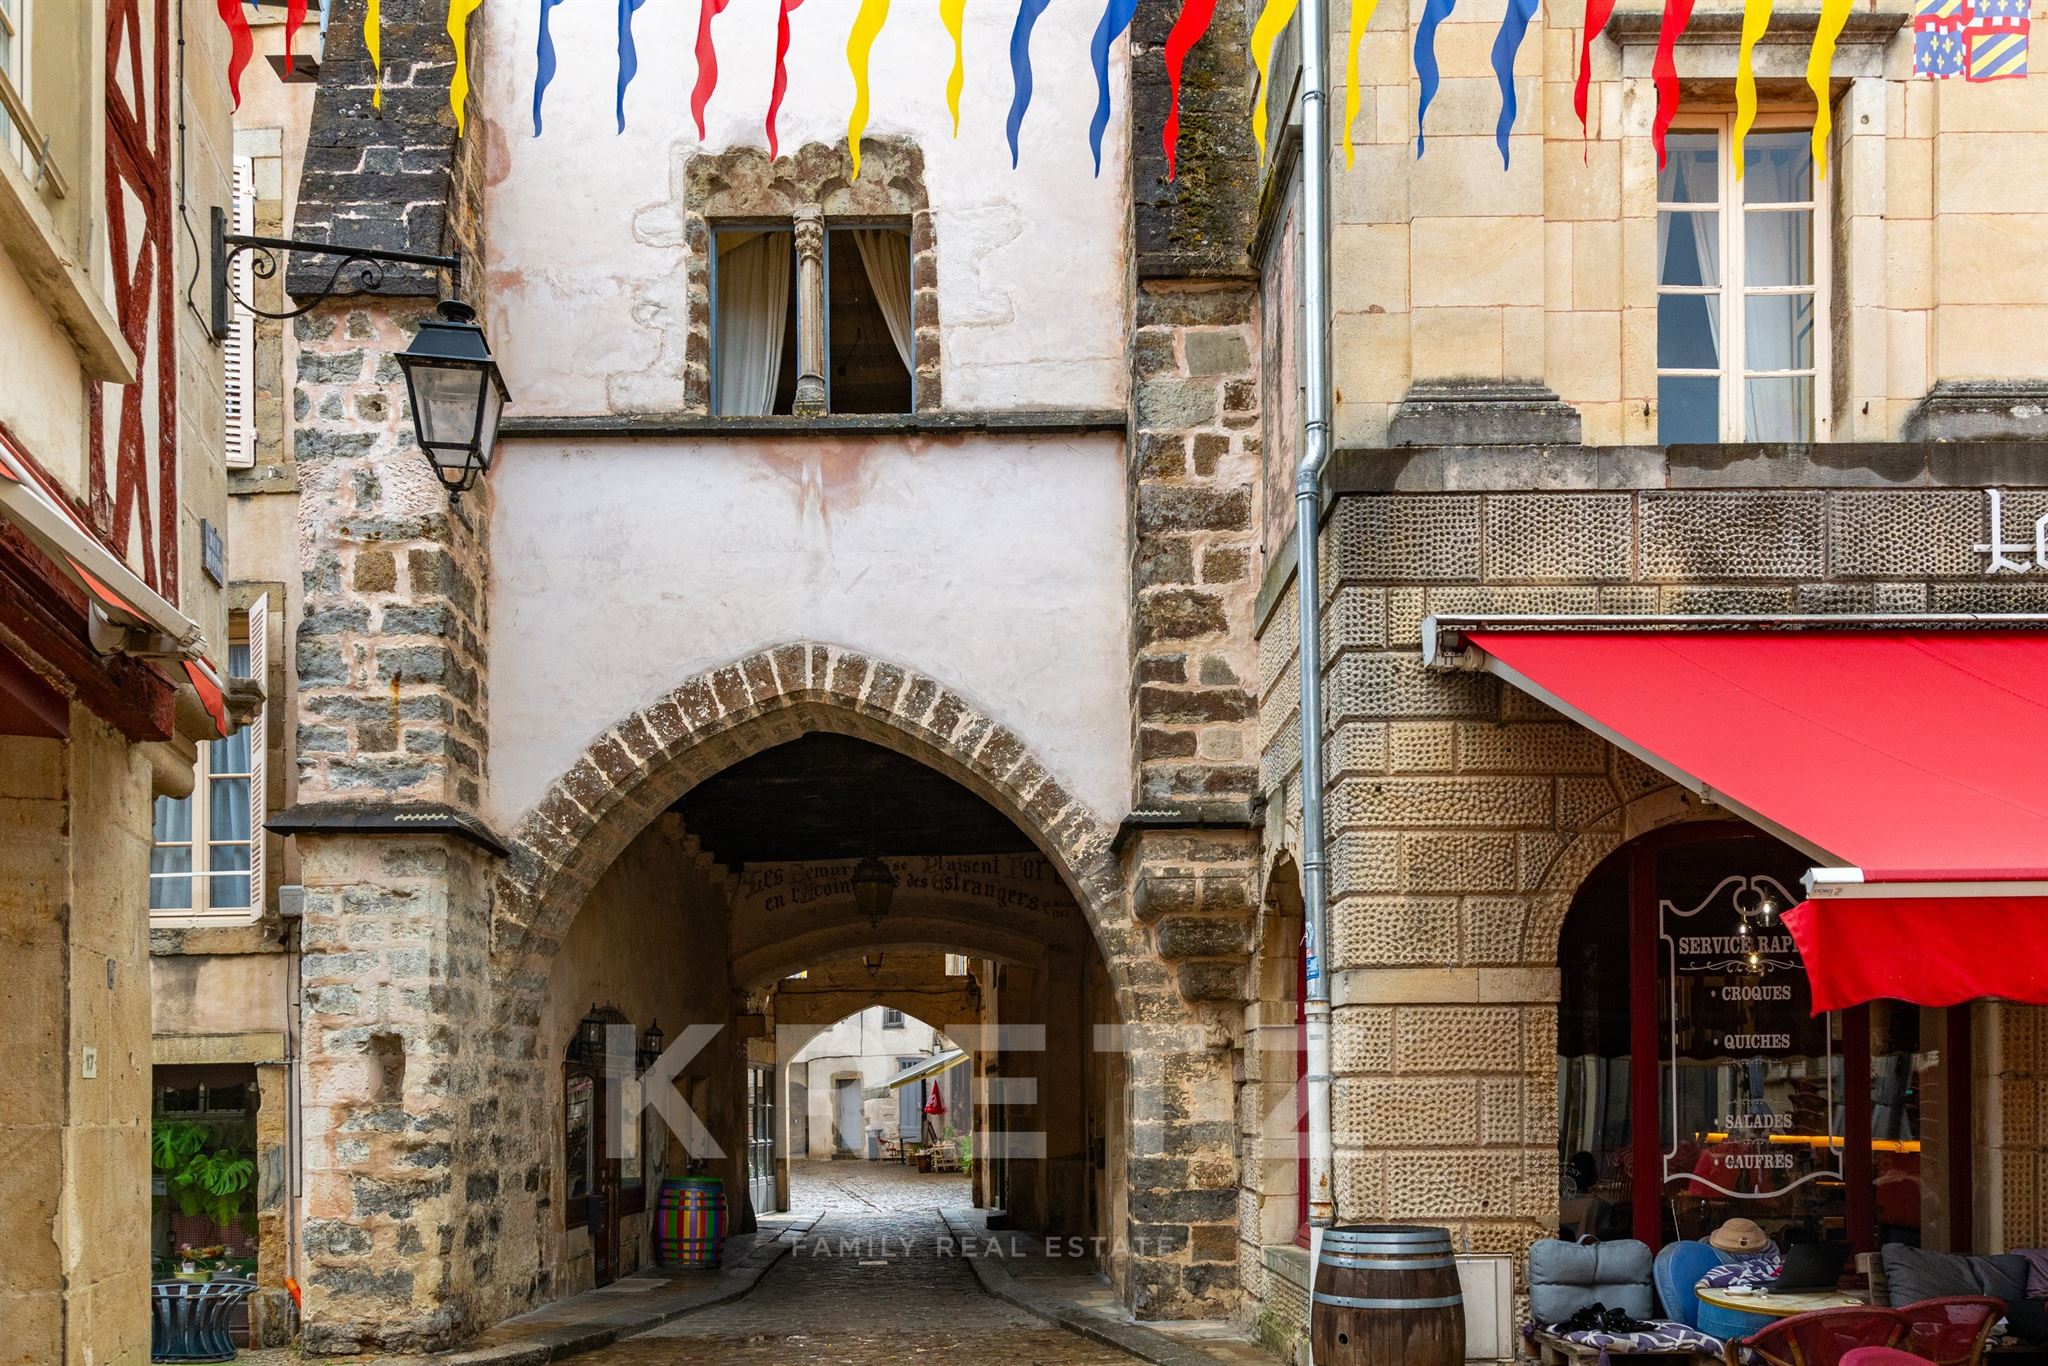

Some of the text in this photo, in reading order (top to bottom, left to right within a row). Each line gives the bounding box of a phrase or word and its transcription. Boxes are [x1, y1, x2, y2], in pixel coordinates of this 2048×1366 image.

[743, 868, 782, 899] Les
[892, 861, 908, 872] se
[922, 855, 1001, 875] Plaisent
[763, 894, 786, 912] en
[907, 872, 929, 889] des
[1679, 935, 1800, 955] SERVICE RAPI
[1721, 985, 1792, 1001] CROQUES
[1724, 1034, 1791, 1049] QUICHES
[85, 1054, 95, 1072] 17
[1725, 1114, 1792, 1129] SALADES
[1725, 1154, 1794, 1169] GAUFRES
